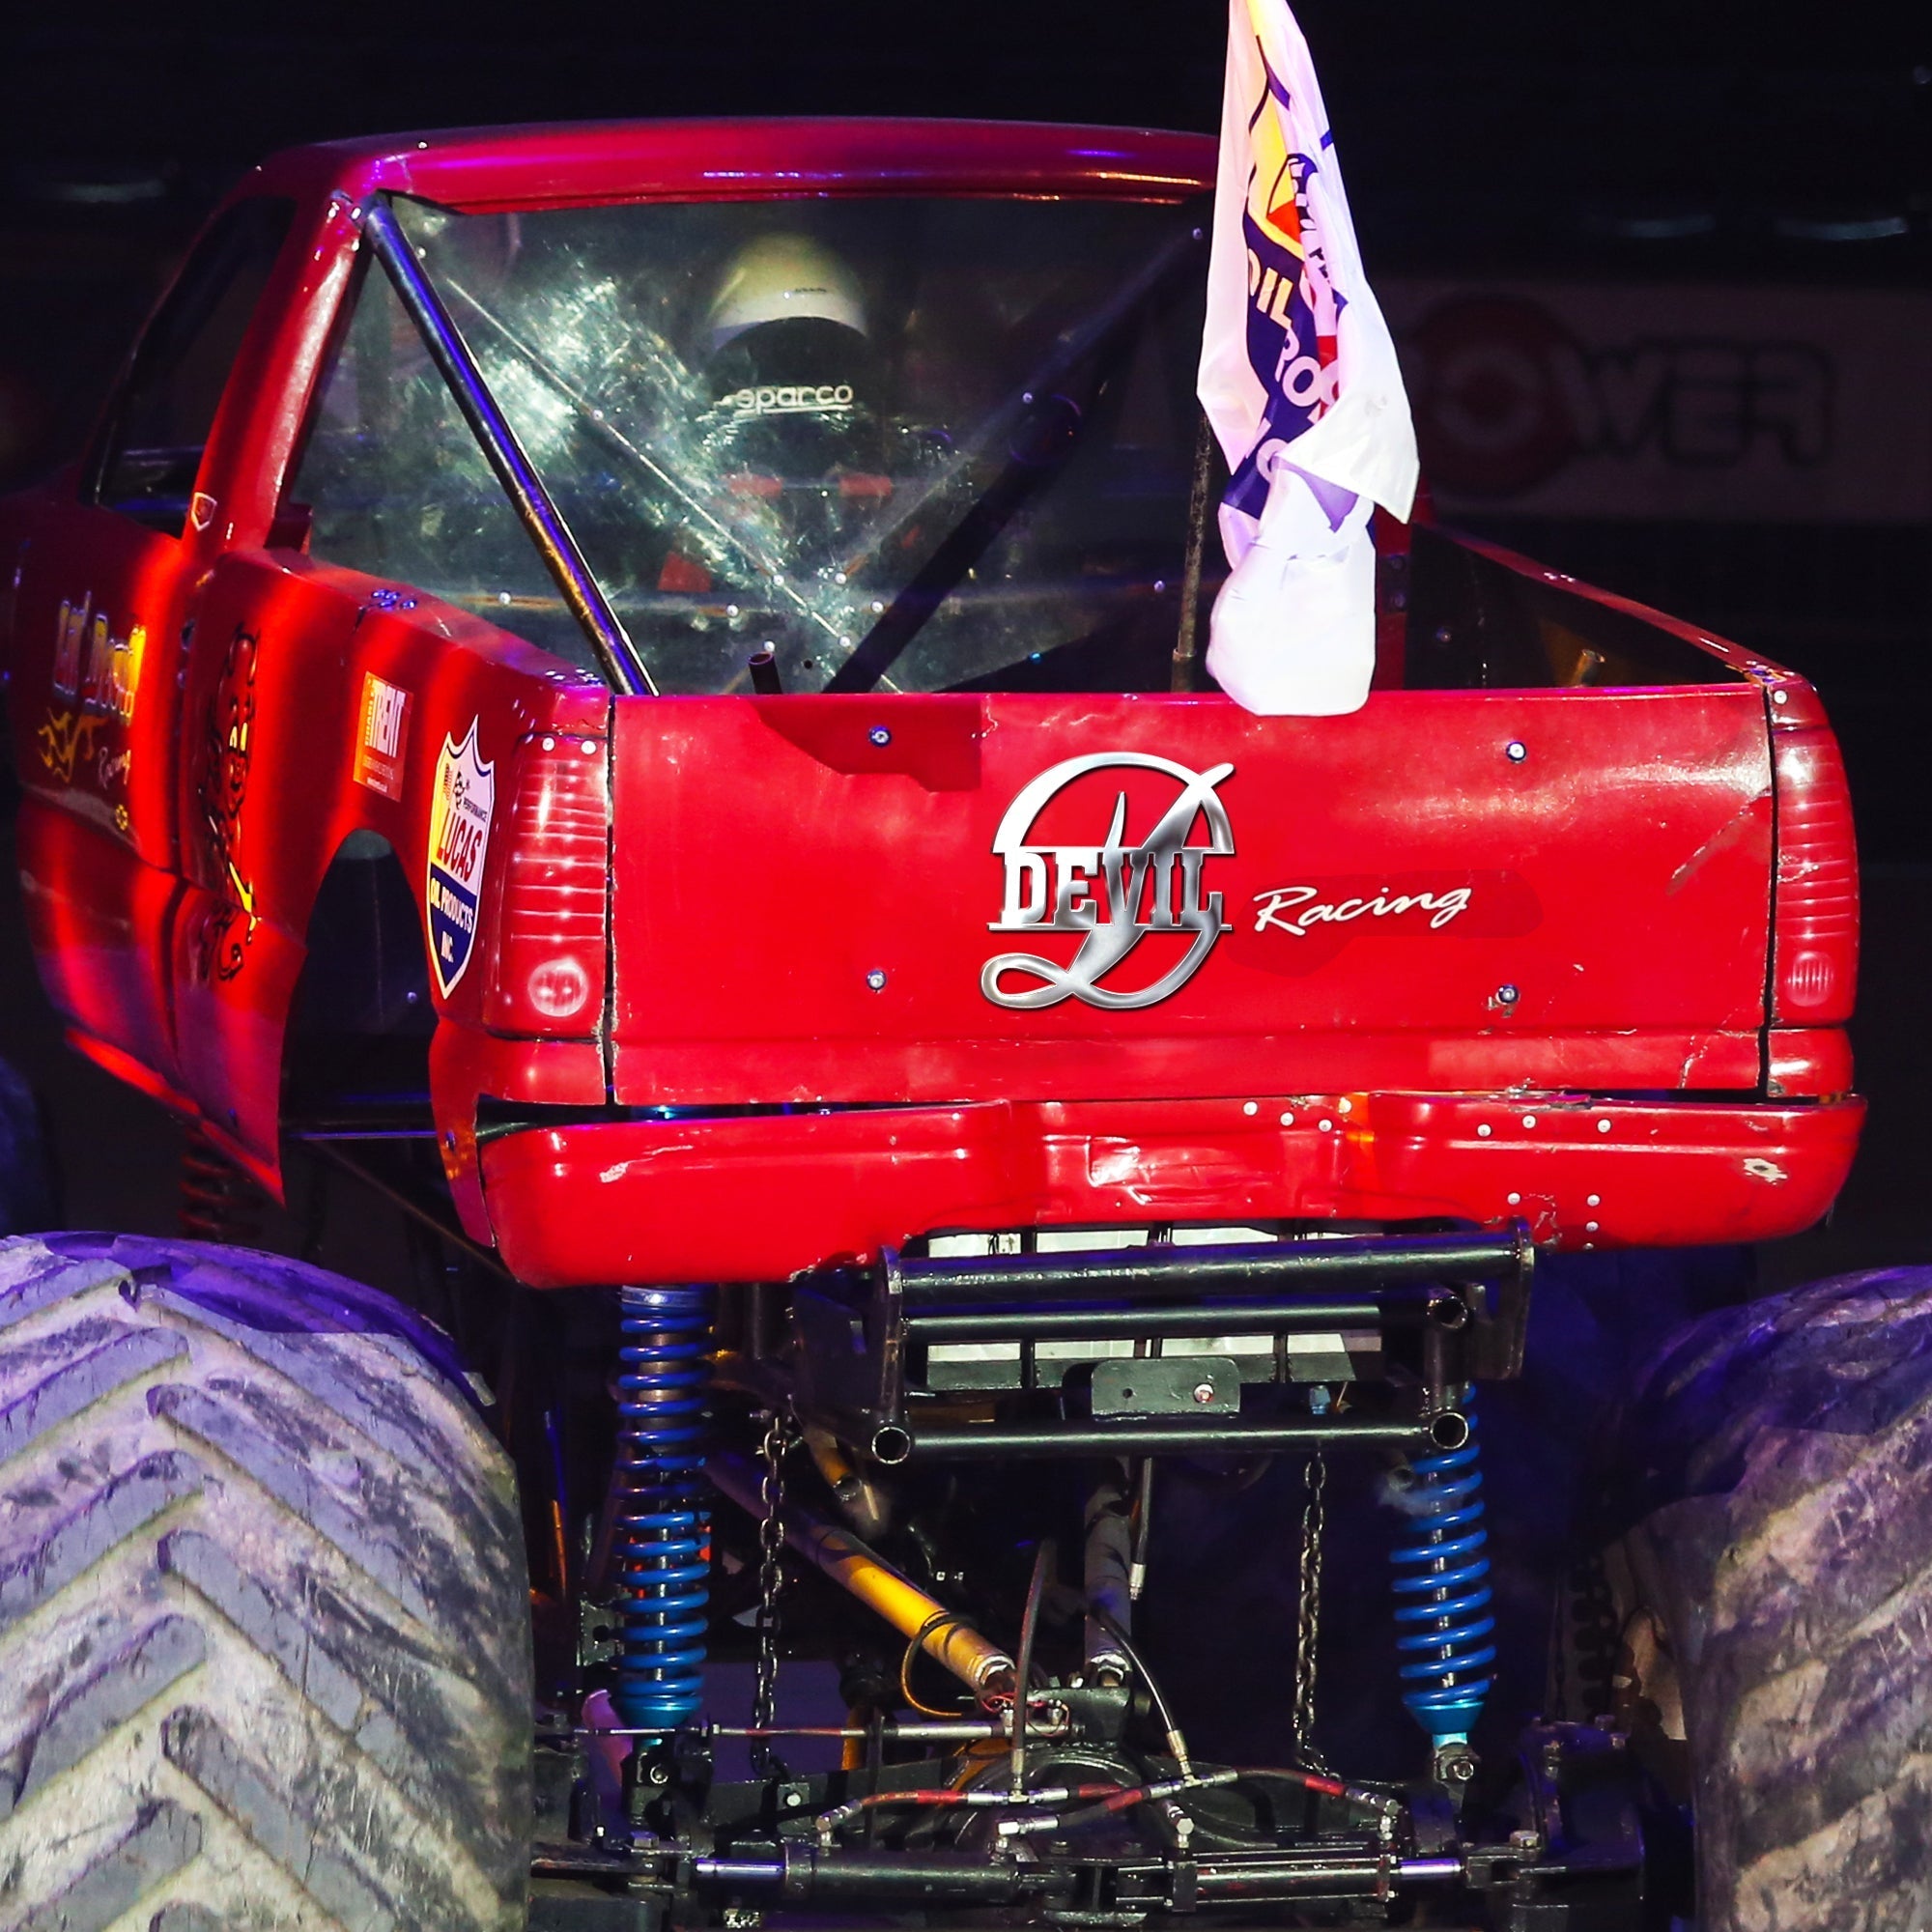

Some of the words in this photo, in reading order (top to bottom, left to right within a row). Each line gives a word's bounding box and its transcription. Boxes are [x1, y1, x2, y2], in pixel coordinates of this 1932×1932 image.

[1398, 317, 1836, 481] OWER
[369, 678, 407, 759] TRENT
[436, 808, 483, 883] LUCAS
[440, 886, 473, 935] PRODUCTS
[988, 847, 1234, 931] DEVIL
[1253, 886, 1472, 937] Racing
